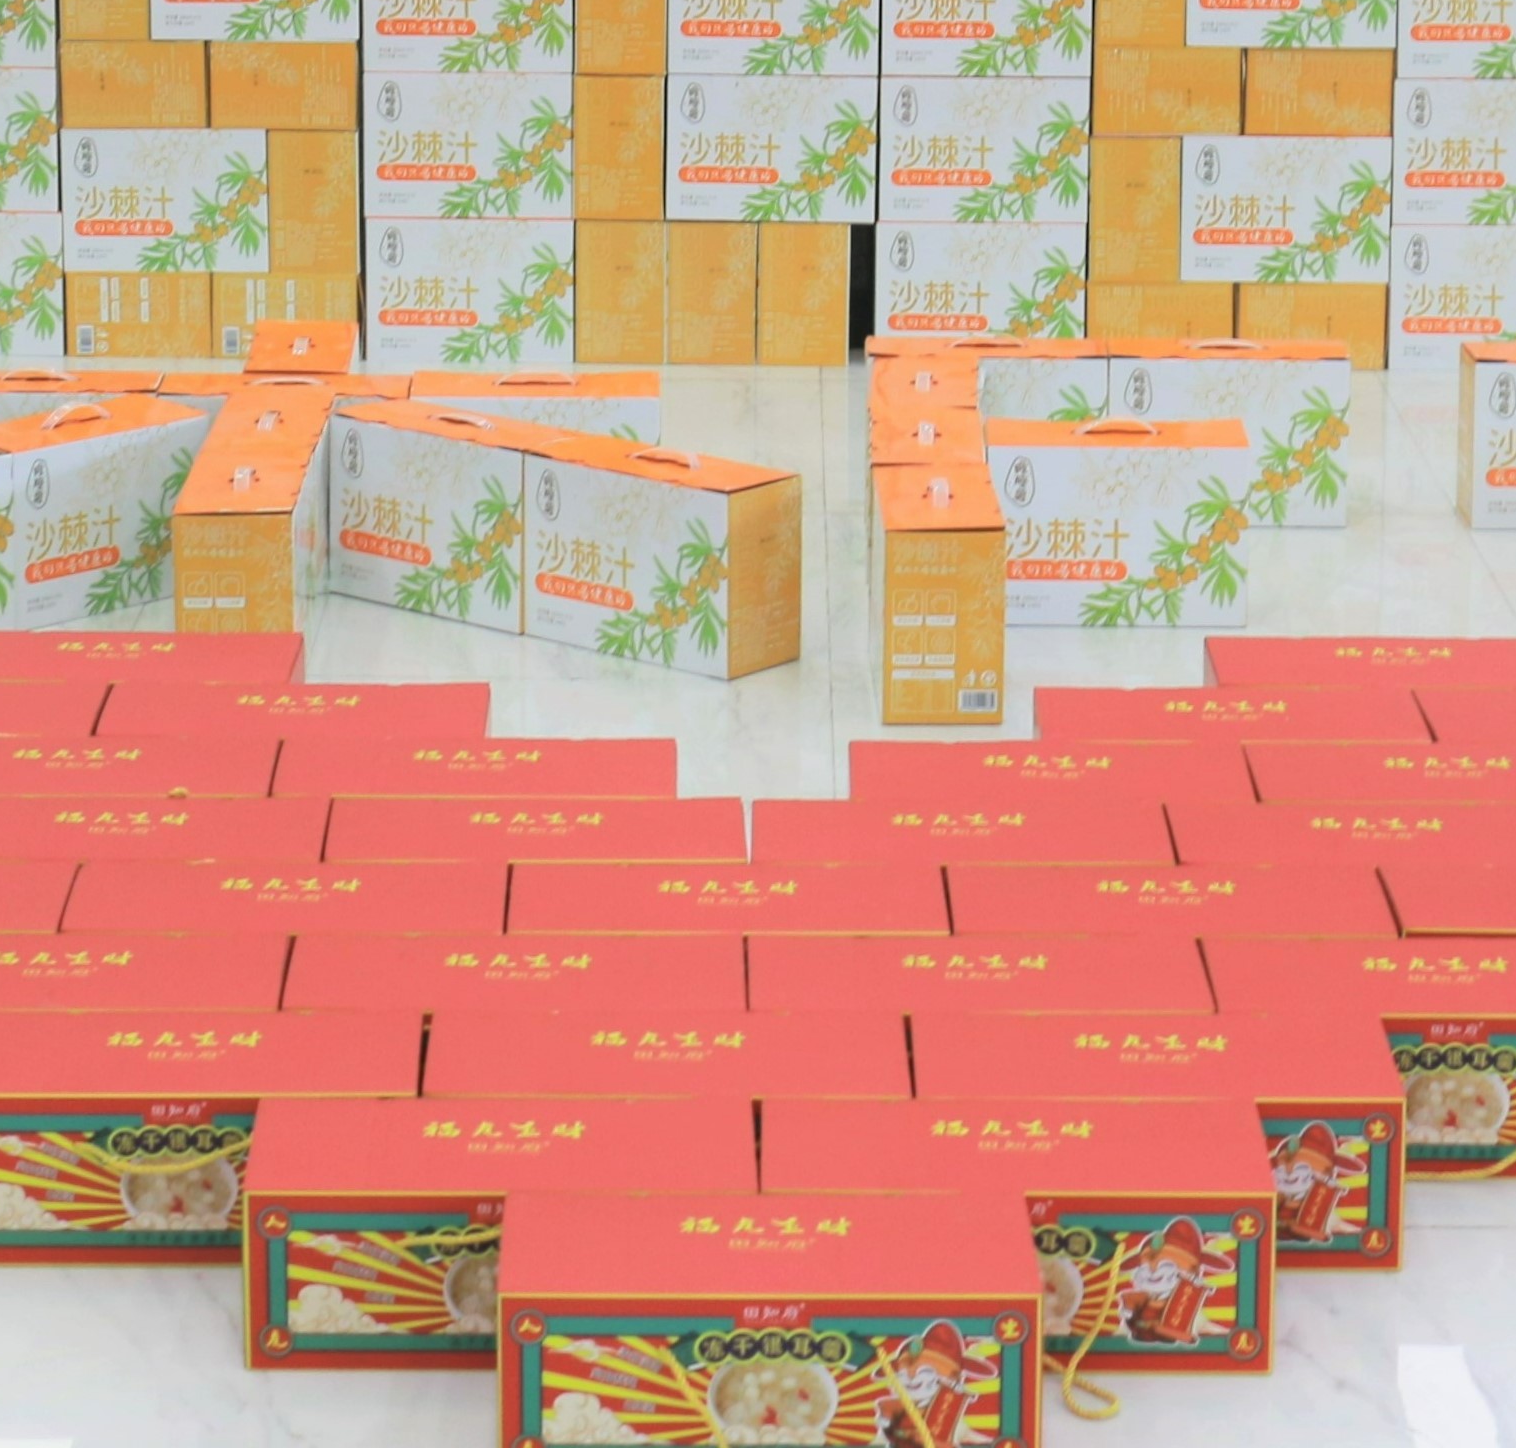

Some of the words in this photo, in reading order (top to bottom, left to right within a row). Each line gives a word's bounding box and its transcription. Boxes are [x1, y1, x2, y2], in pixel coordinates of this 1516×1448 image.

[377, 131, 476, 166] 沙棘汁
[679, 133, 779, 168] 沙棘汁
[892, 137, 992, 170] 沙棘汁
[1405, 139, 1505, 172] 沙棘汁
[75, 187, 173, 221] 沙棘汁
[1194, 196, 1293, 229] 沙棘汁
[379, 277, 478, 311] 沙棘汁
[888, 282, 988, 315] 沙棘汁
[1403, 285, 1502, 318] 沙棘汁
[25, 510, 120, 566] 沙棘汁
[341, 493, 432, 549] 沙棘汁
[1004, 517, 1130, 560] 沙棘汁
[536, 536, 633, 592] 沙棘汁
